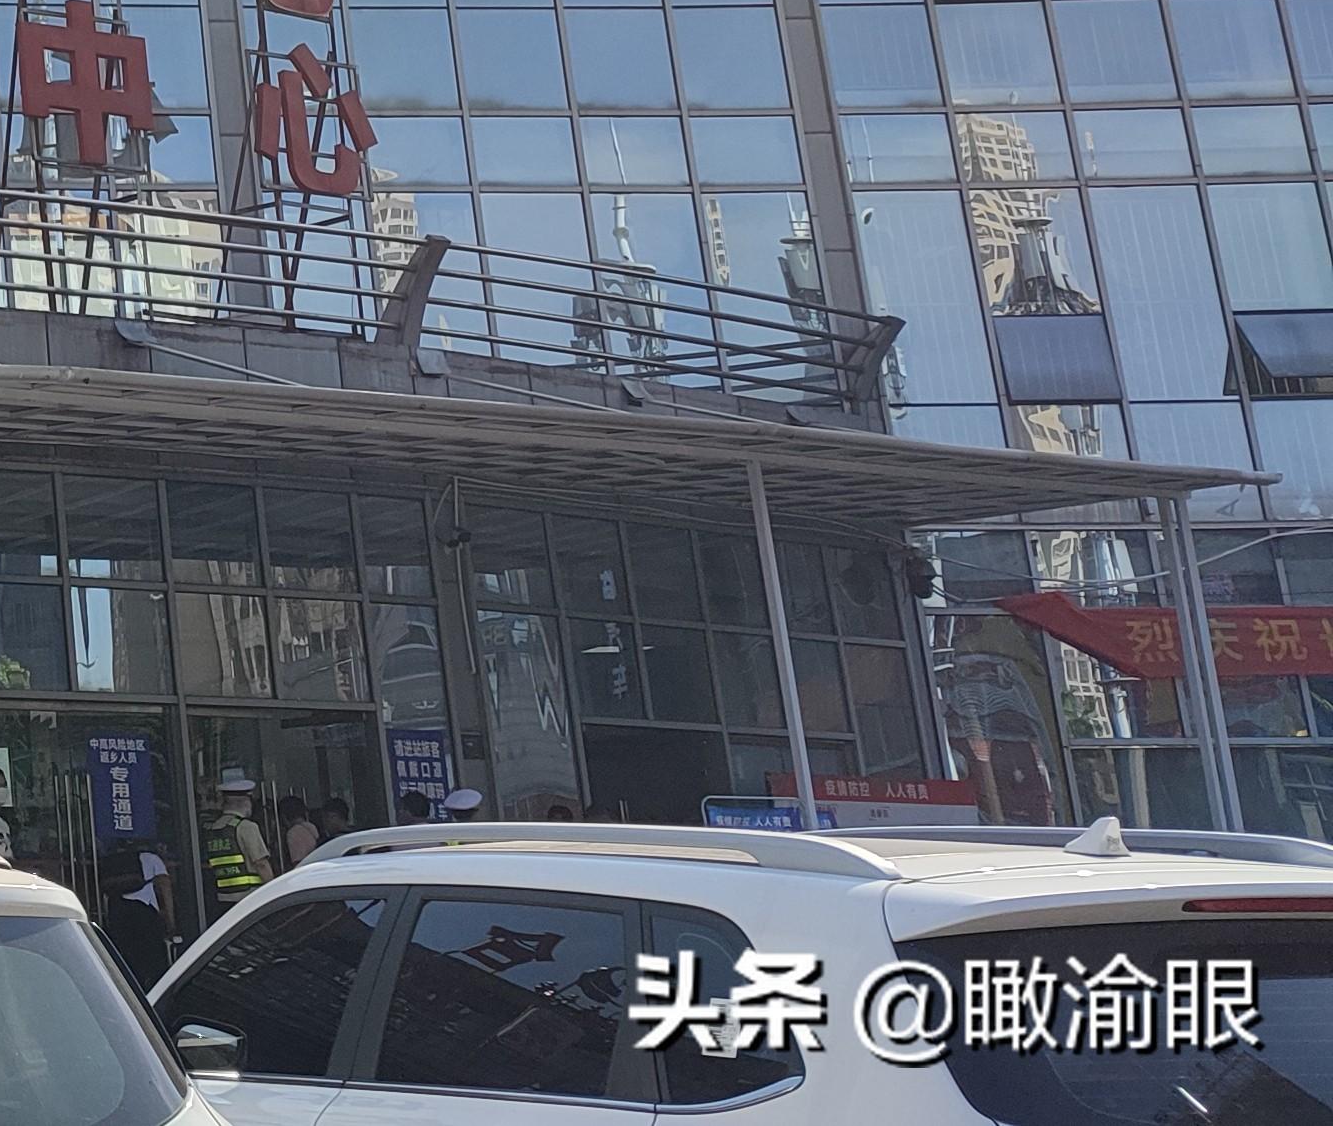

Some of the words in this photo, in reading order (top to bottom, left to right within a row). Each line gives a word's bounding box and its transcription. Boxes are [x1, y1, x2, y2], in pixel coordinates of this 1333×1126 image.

[89, 737, 146, 752] 中高风险地区
[99, 750, 138, 764] 返乡人员
[824, 779, 871, 798] 疫情防控
[885, 781, 930, 800] 人人有责
[109, 766, 134, 831] 专用通道
[755, 815, 793, 828] 人人有责
